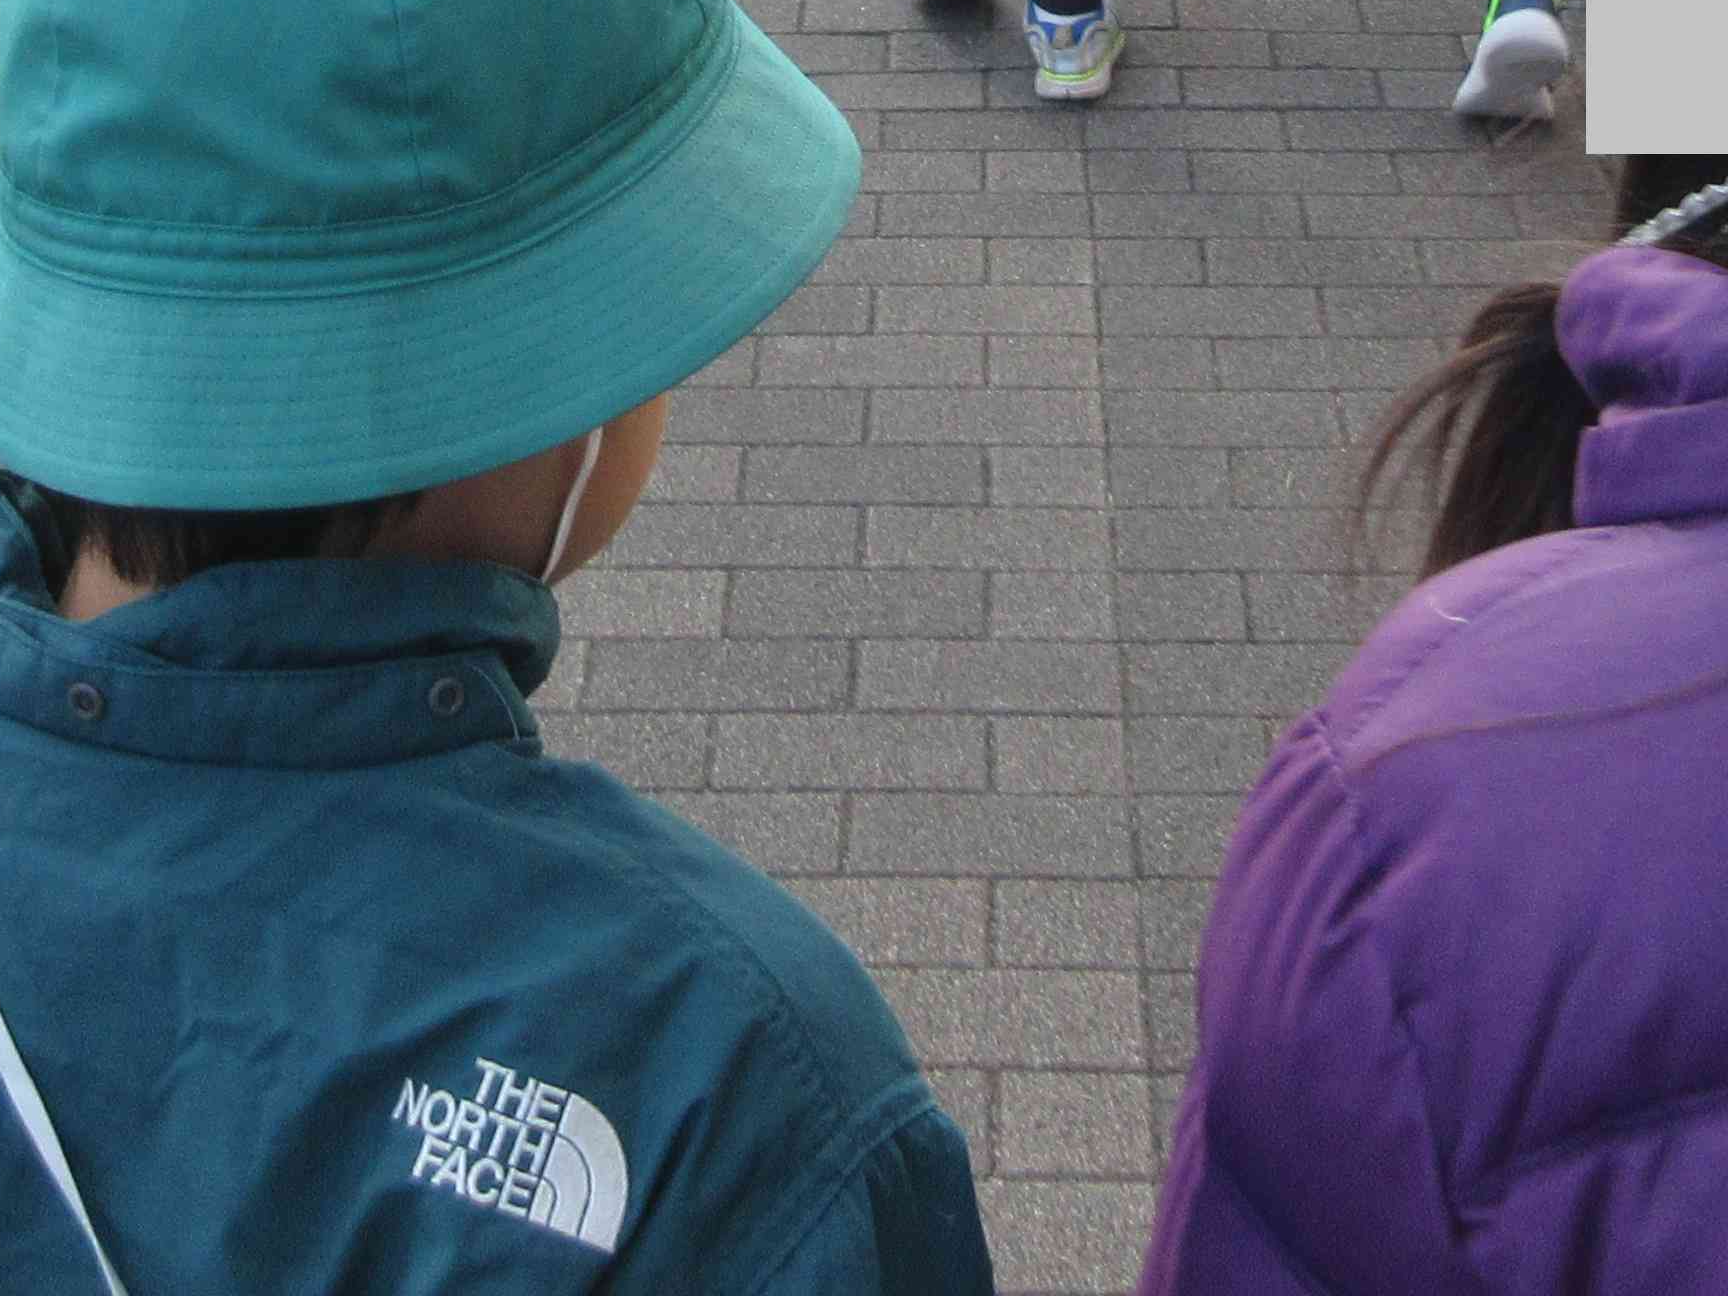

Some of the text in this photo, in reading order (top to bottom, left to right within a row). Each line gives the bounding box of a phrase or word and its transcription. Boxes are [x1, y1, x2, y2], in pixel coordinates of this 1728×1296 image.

[391, 1078, 558, 1175] NORTH
[475, 1056, 568, 1129] THE
[412, 1138, 538, 1217] FACE
